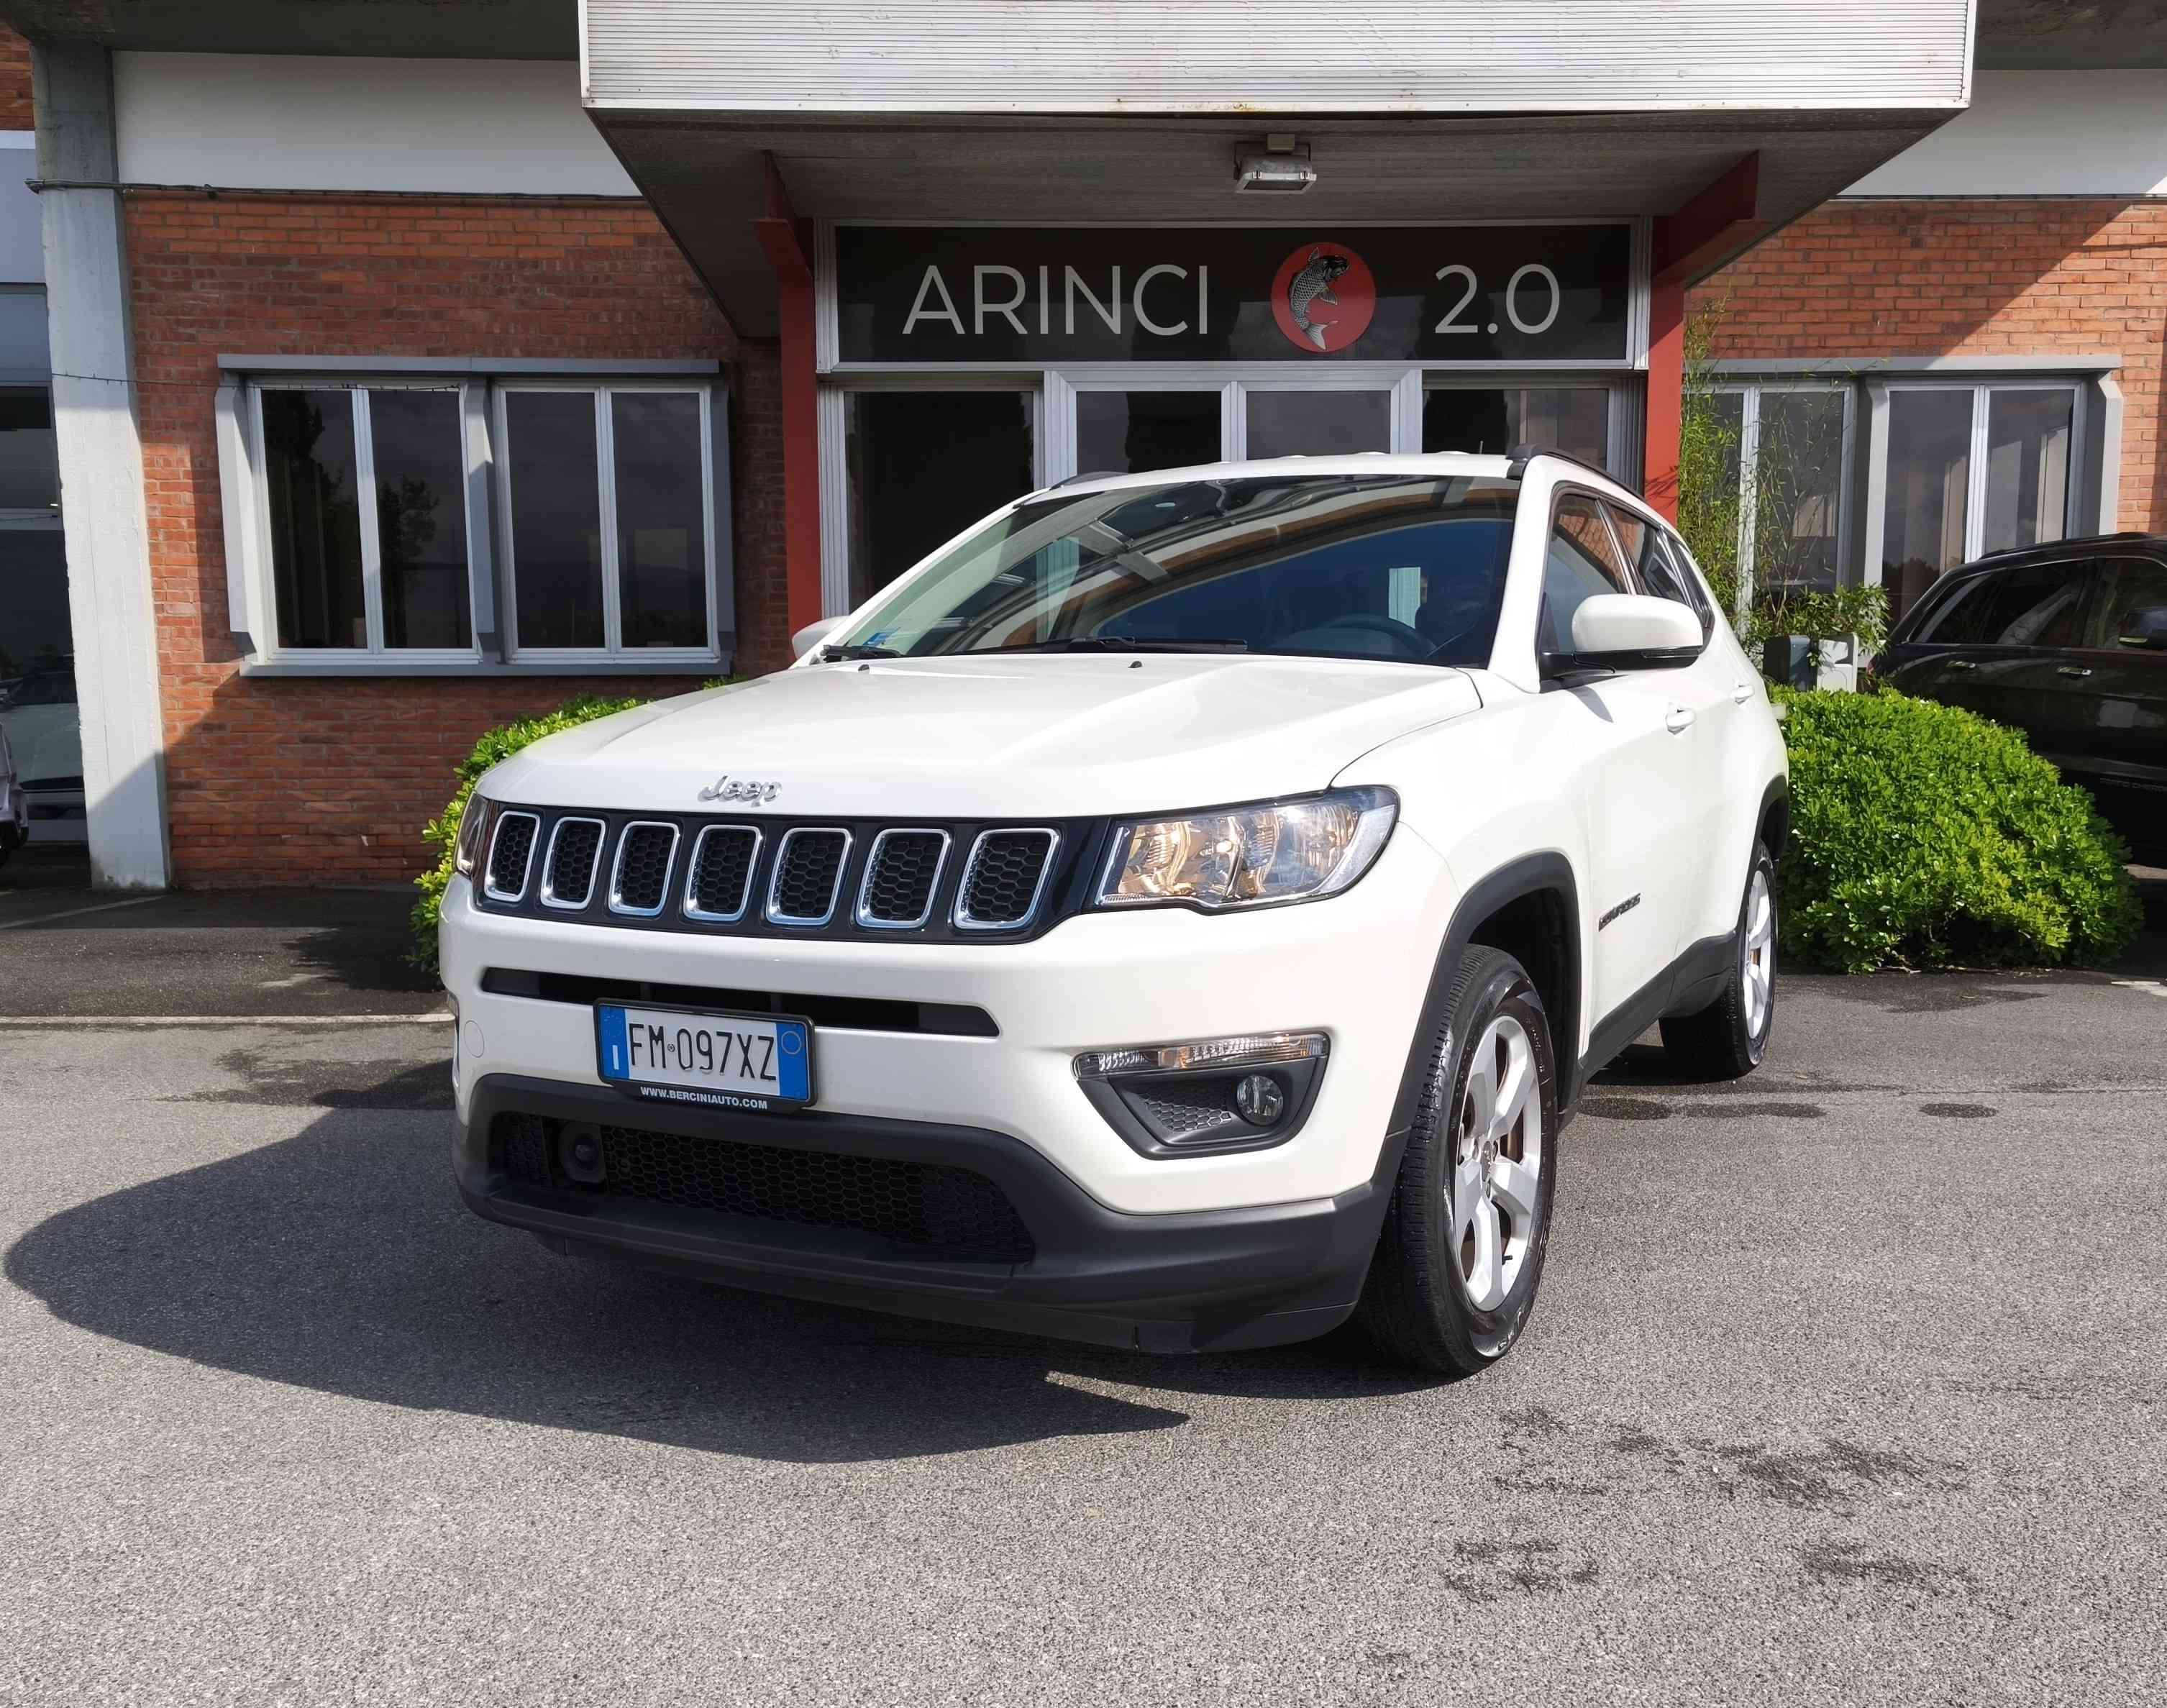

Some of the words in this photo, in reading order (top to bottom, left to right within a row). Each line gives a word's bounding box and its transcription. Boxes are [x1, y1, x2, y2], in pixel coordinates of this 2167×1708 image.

[902, 264, 1208, 337] ARINCI
[1435, 265, 1561, 335] 2.0
[698, 775, 783, 808] Jeep
[640, 1087, 768, 1110] WWW.BERCINIAUTO.COM
